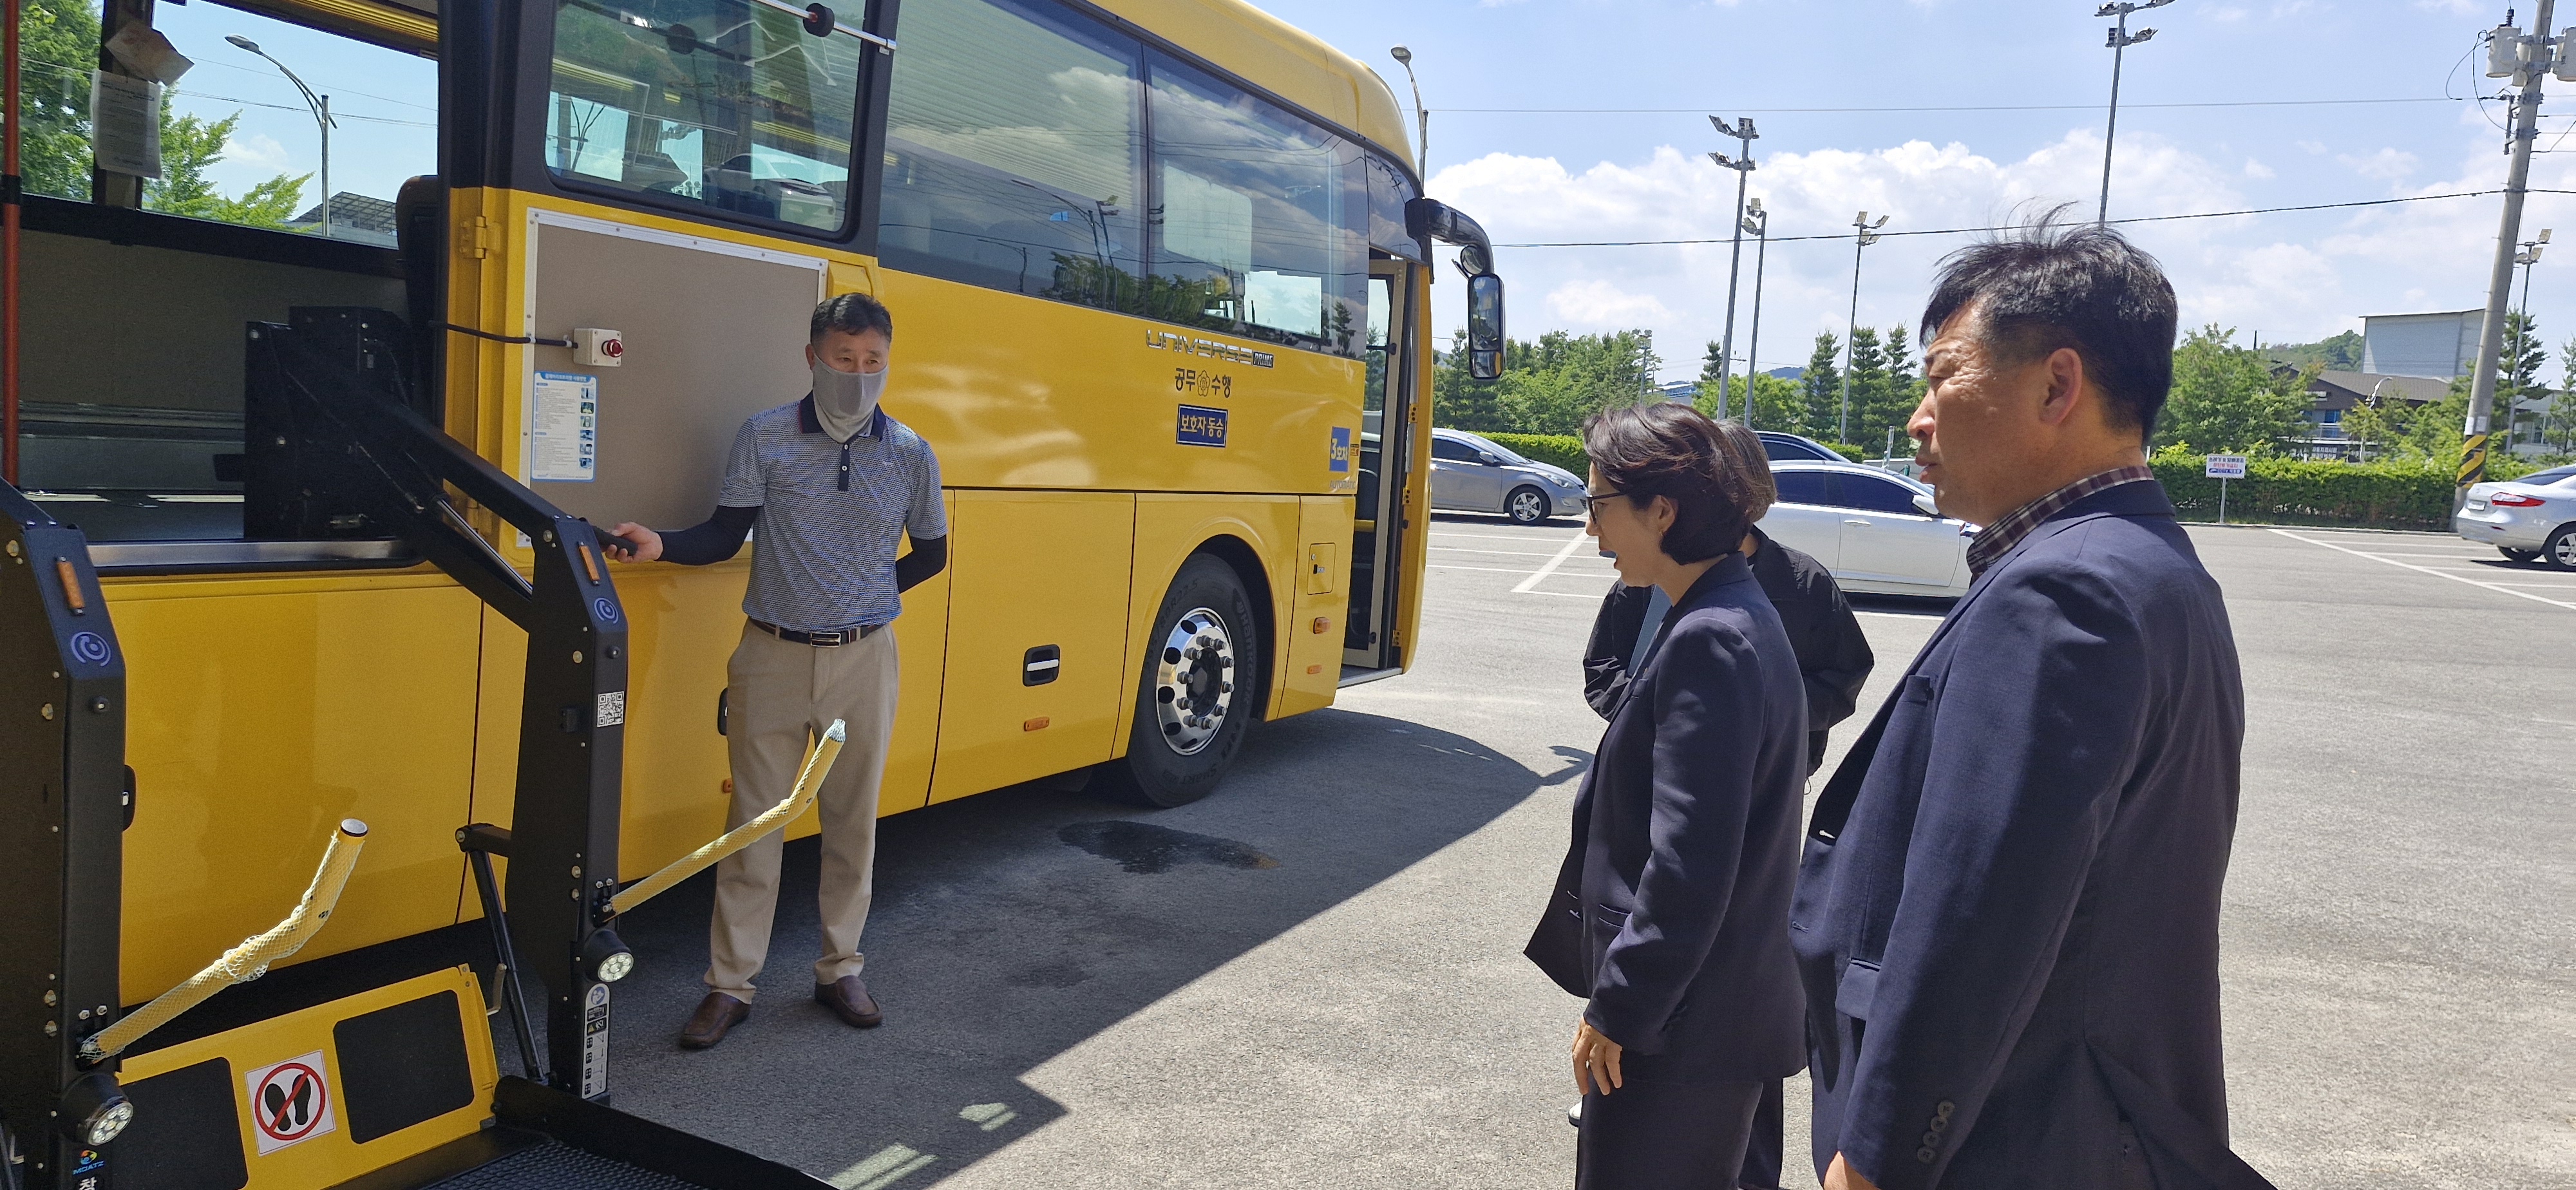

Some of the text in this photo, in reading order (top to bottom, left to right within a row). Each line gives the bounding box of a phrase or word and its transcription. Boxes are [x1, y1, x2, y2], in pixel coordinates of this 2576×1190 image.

[1146, 329, 1273, 367] UNIVERSE PRIME
[1175, 368, 1231, 399] 공무 수행
[1180, 415, 1224, 438] 보호자 동승
[1331, 438, 1348, 461] 3호차
[1329, 480, 1356, 490] AUTOMATIC
